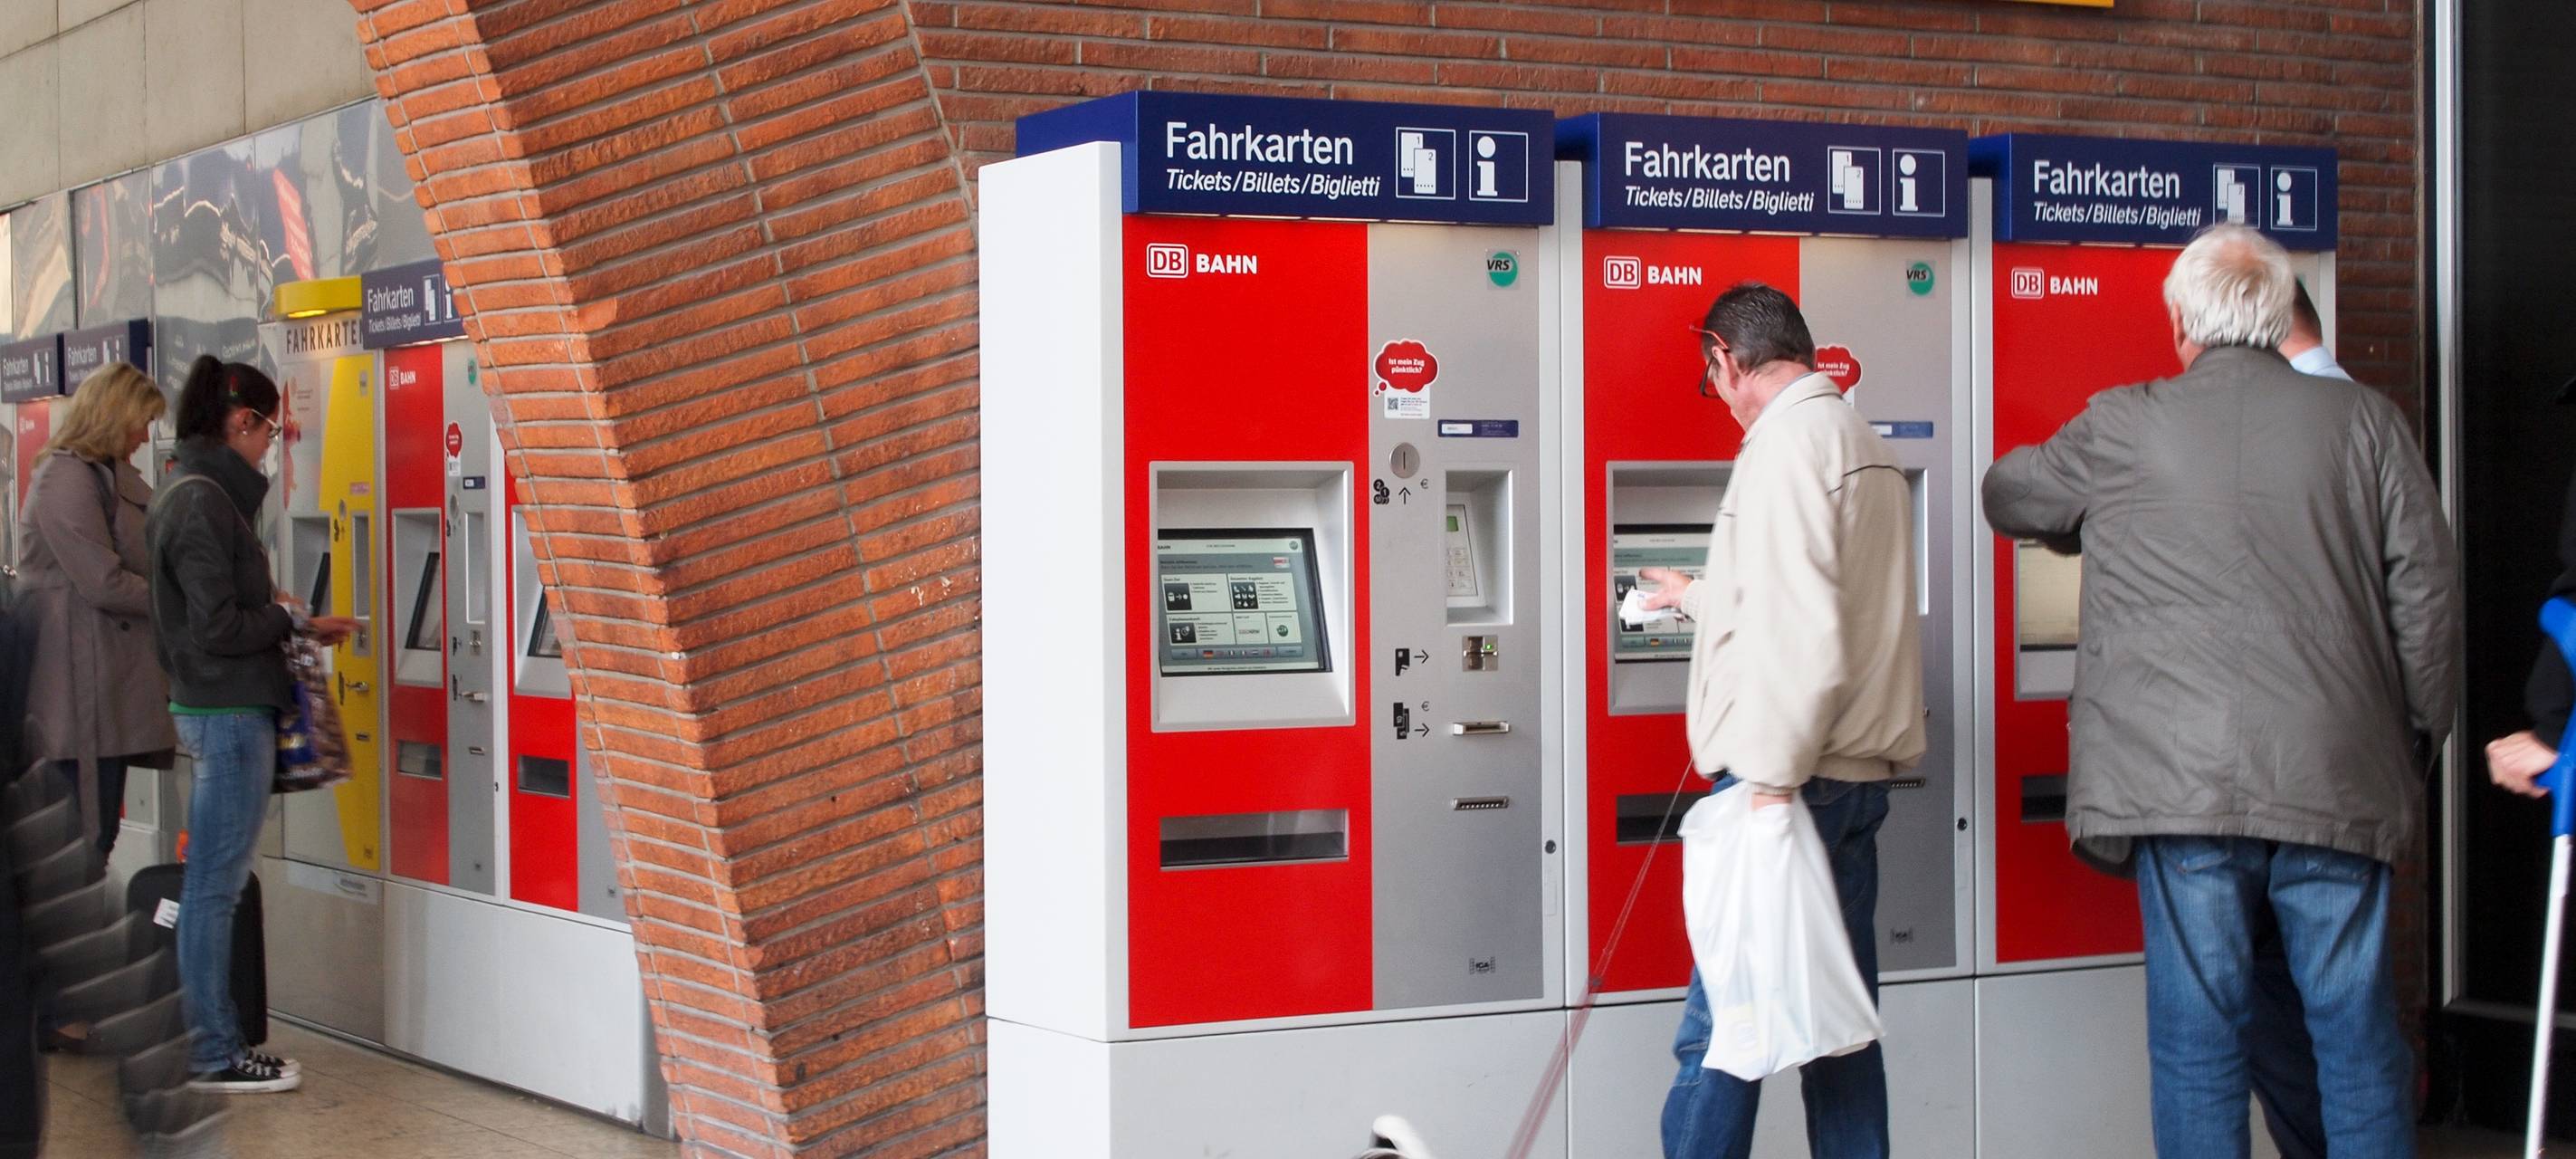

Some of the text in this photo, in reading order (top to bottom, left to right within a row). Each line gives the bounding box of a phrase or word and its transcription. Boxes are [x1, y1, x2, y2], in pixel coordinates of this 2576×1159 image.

[1167, 121, 1353, 165] Fahrkarten
[1625, 141, 1790, 182] Fahrkarten
[2034, 159, 2180, 199] Fahrkarten
[1151, 249, 1257, 274] DB BAHN
[1487, 259, 1510, 271] VRS
[1608, 262, 1703, 286] DB BAHN
[1906, 269, 1927, 281] VRS
[2015, 273, 2098, 295] DB BAHN
[367, 284, 415, 313] Fahrkarten
